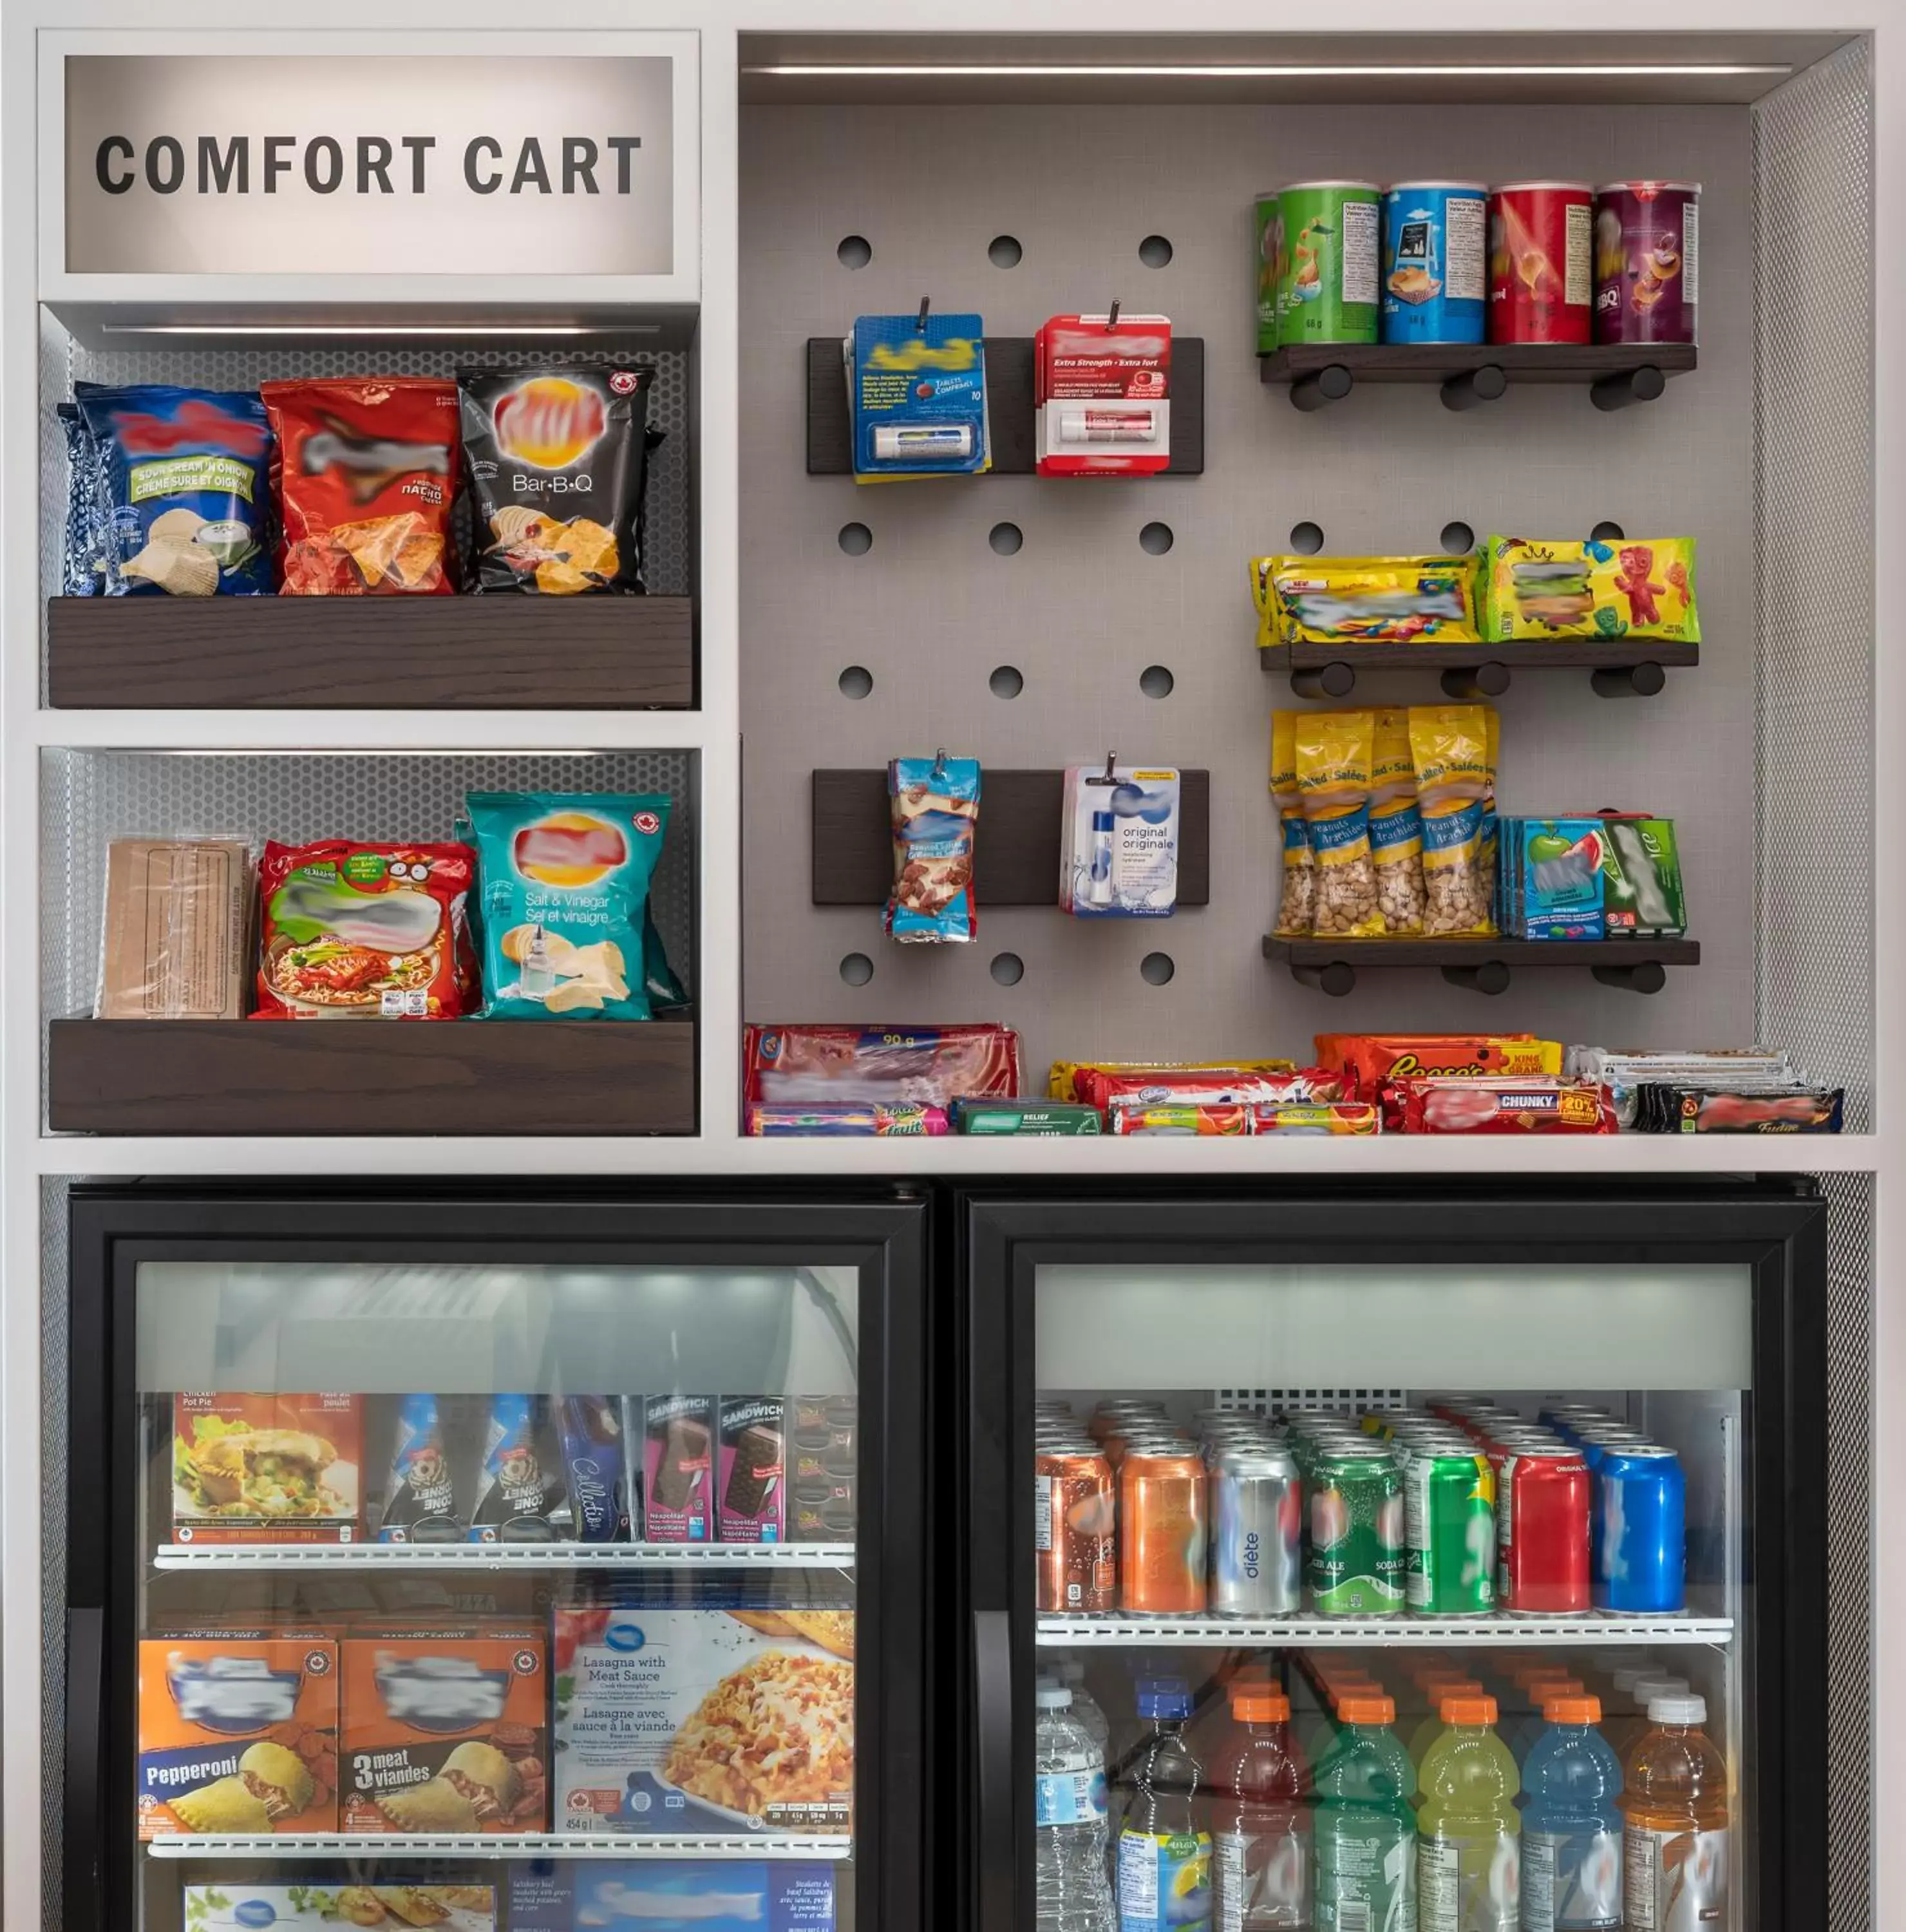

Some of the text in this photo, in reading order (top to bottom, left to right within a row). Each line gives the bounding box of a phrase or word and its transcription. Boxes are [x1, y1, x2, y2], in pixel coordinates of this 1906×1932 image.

[96, 136, 642, 194] COMFORT CART
[1077, 358, 1113, 368] Strength
[936, 376, 961, 387] TABLETS
[971, 391, 981, 401] 10
[139, 466, 165, 481] SOUR
[166, 460, 203, 474] CREAM
[218, 462, 248, 480] ONION
[169, 475, 196, 487] SURE
[198, 475, 212, 485] ET
[214, 475, 248, 495] OIGNON
[1425, 815, 1464, 832] Peanuts
[1123, 827, 1167, 838] original
[1122, 838, 1174, 851] originale
[525, 893, 609, 910] Salt & Vinegar
[525, 909, 609, 927] Sel et vinaigre
[883, 1034, 915, 1048] 90 g
[1514, 1054, 1540, 1063] KING
[1501, 1095, 1553, 1108] CHUNKY
[1565, 1097, 1594, 1112] 20%
[886, 1120, 923, 1135] fruit
[323, 1398, 351, 1408] poulet
[648, 1398, 709, 1420] SANDWICH
[722, 1405, 784, 1426] SANDWICH
[424, 1493, 452, 1510] CONE
[514, 1493, 544, 1510] CONE
[1243, 1532, 1259, 1579] diète
[1326, 1561, 1345, 1571] ALE
[1375, 1560, 1397, 1571] SODA
[583, 1655, 666, 1670] Lasagna with
[589, 1670, 661, 1681] Meat Sauce
[583, 1707, 666, 1721] Lasagne avec
[572, 1719, 676, 1732] sauce à la viande
[146, 1756, 238, 1786] Pepperoni
[354, 1748, 409, 1790] 3 meat
[374, 1765, 430, 1787] viandes
[566, 1818, 587, 1831] 454 g
